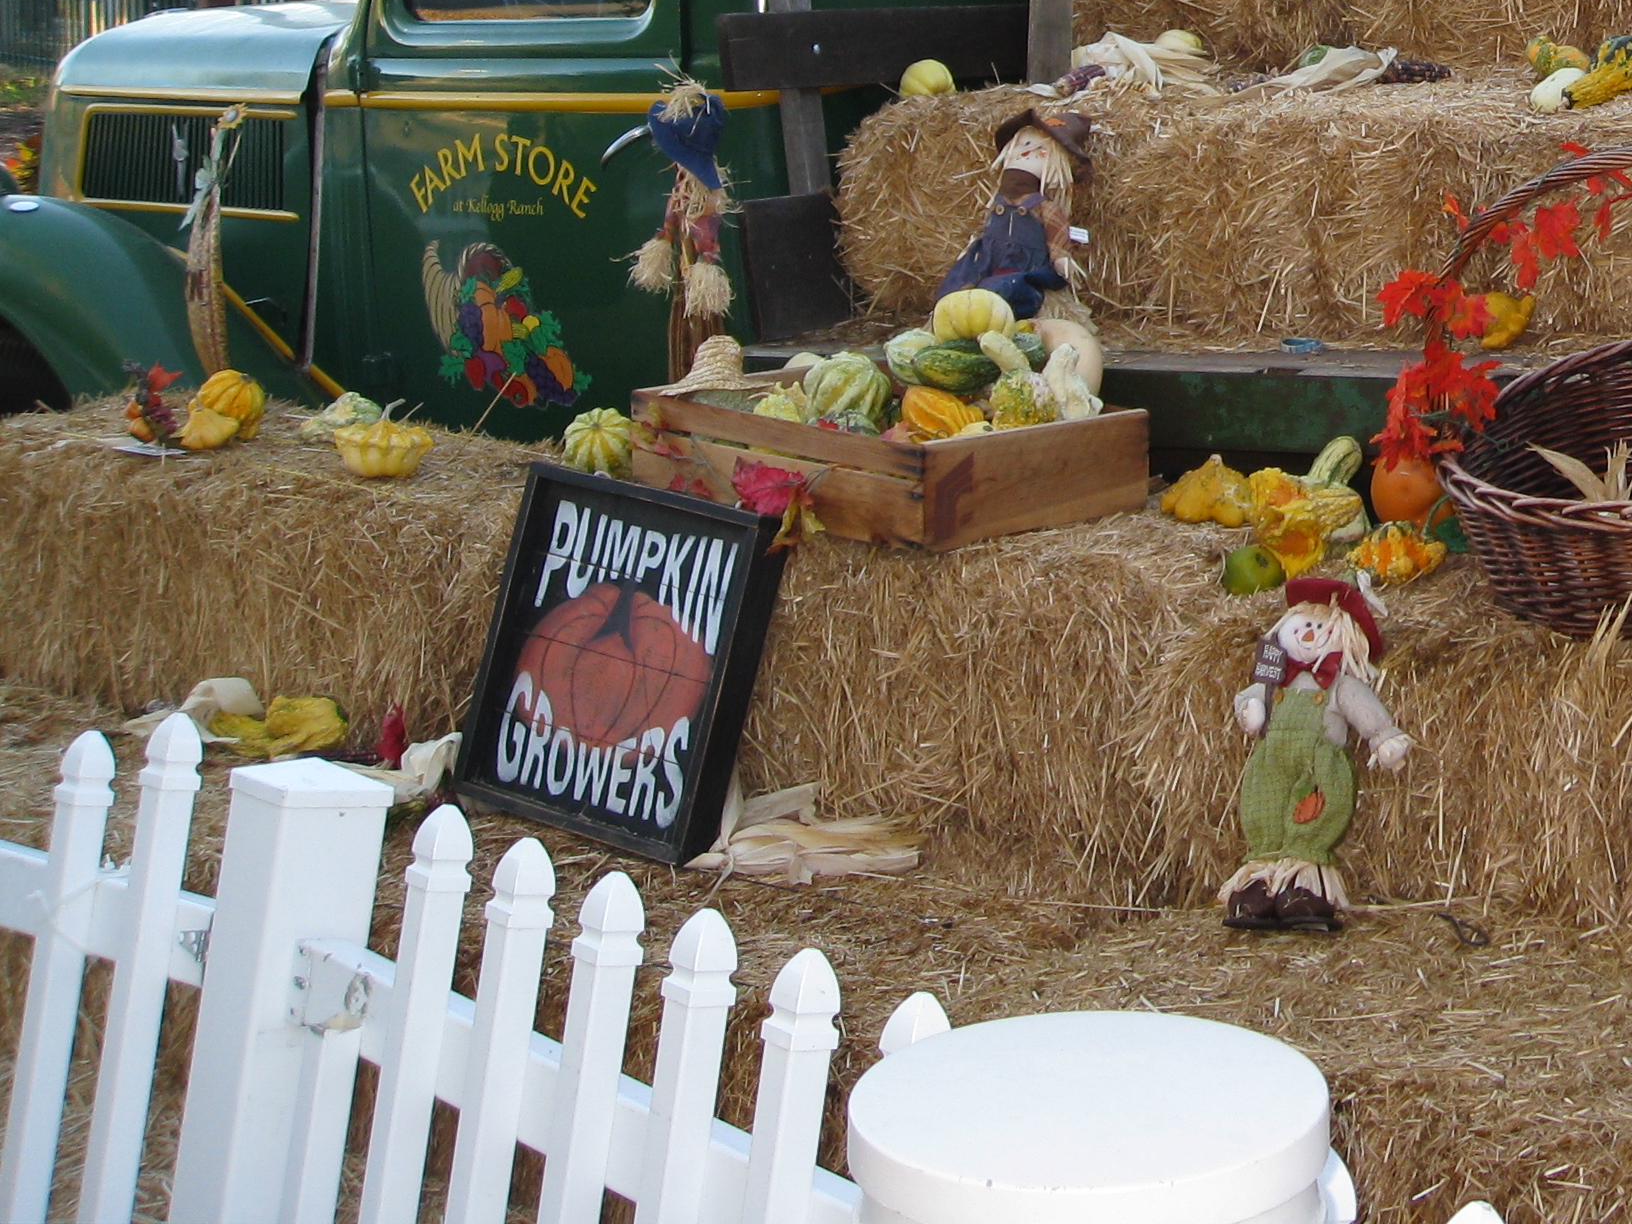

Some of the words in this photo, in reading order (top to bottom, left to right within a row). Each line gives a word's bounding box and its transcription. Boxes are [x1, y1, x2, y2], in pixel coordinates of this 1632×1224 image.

[409, 133, 486, 213] FARM
[494, 133, 597, 219] STORE
[453, 200, 464, 212] at
[466, 194, 505, 222] Kellogg
[507, 197, 544, 215] Ranch
[534, 499, 740, 656] PUMPKIN
[496, 670, 691, 830] GROWERS
